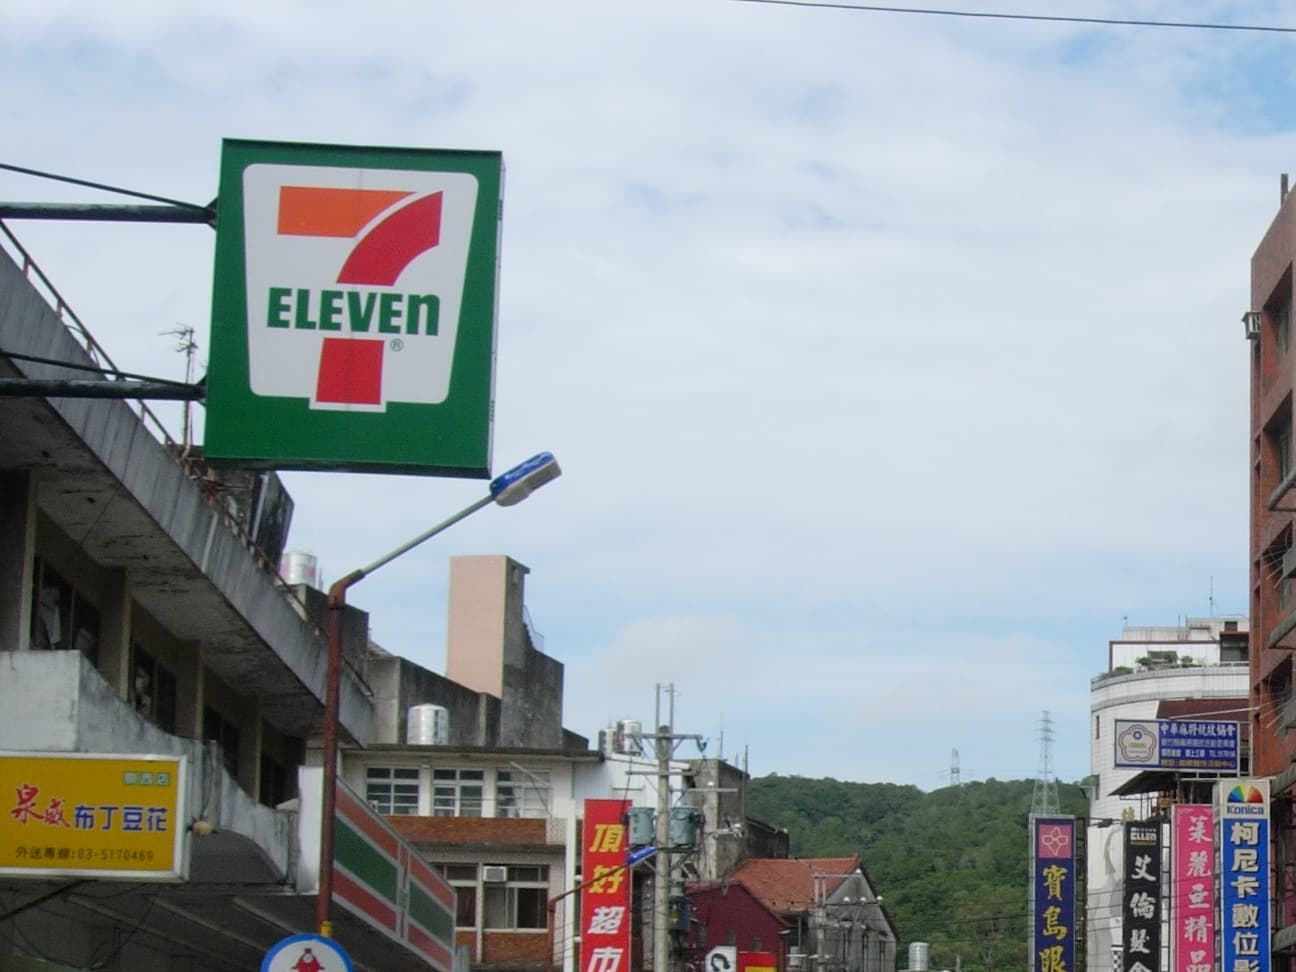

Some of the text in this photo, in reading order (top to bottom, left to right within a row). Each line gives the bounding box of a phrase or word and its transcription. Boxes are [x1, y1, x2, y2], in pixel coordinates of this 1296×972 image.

[75, 805, 168, 831] 布丁豆花
[1227, 805, 1264, 815] Konica
